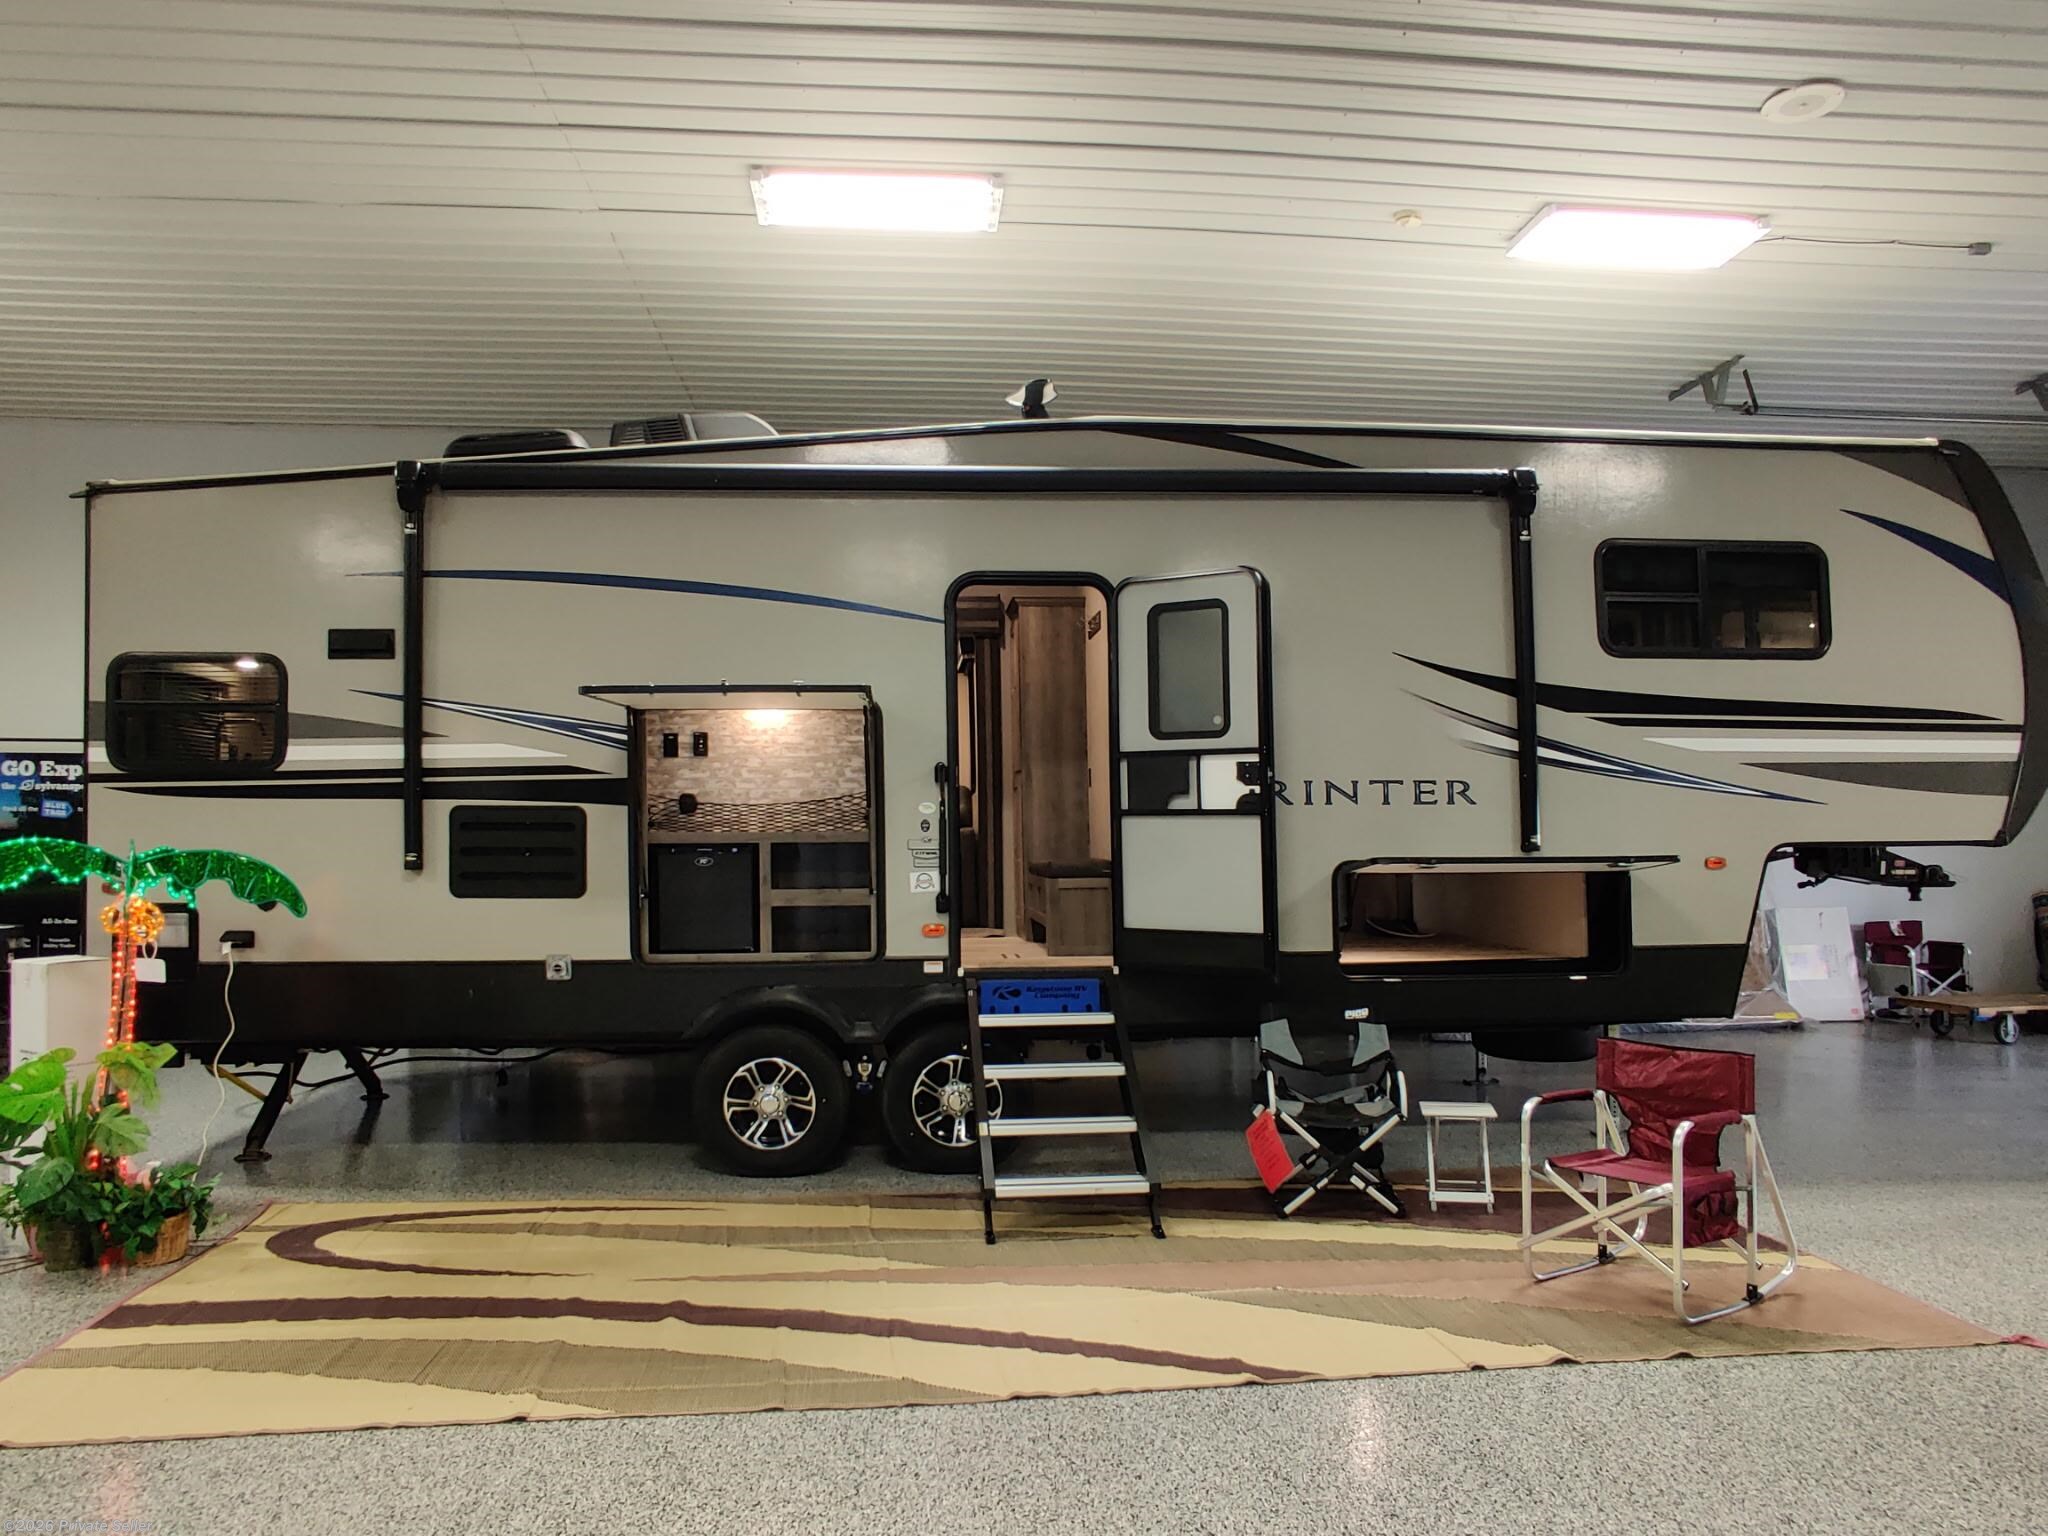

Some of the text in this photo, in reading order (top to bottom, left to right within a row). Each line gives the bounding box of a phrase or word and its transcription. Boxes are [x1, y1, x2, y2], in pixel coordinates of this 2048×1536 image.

[1, 760, 84, 781] GO Exp
[1274, 780, 1477, 806] RINTER
